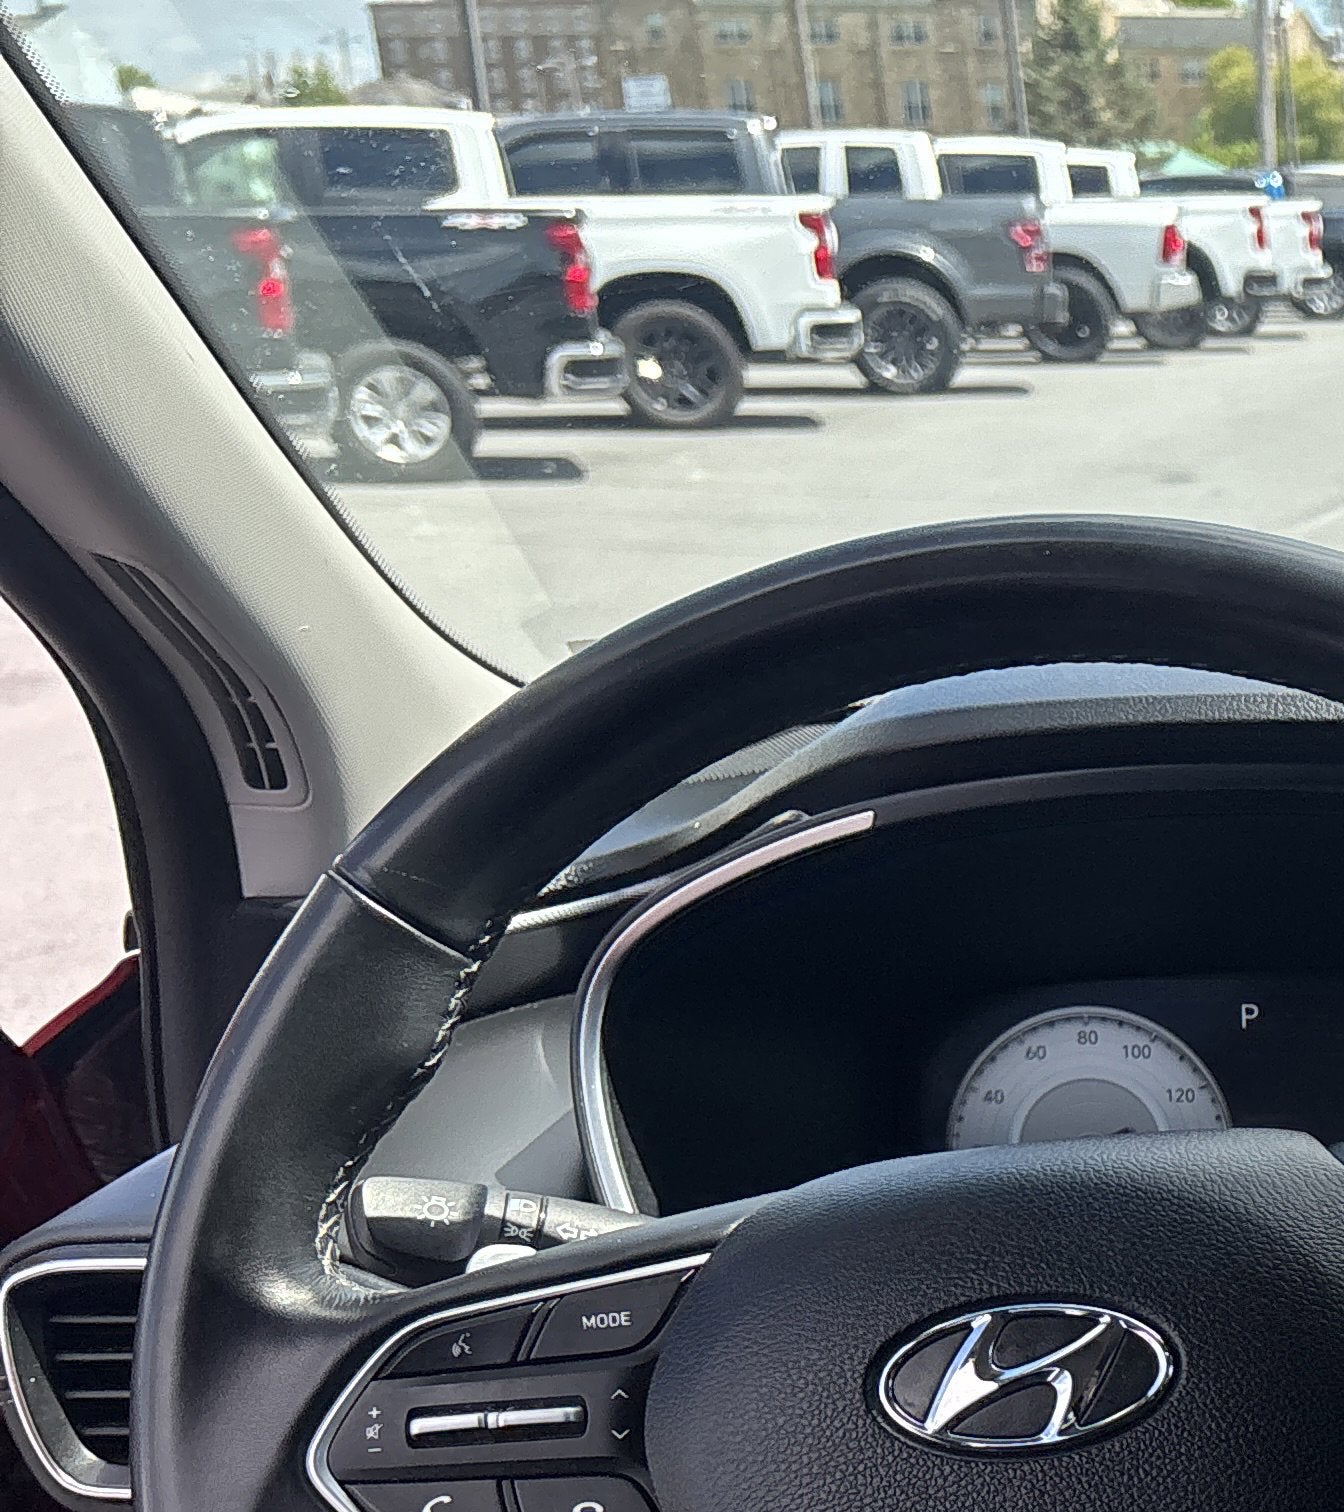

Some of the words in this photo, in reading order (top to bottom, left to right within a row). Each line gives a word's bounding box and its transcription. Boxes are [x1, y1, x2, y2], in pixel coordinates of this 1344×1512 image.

[1240, 1003, 1259, 1030] P
[1076, 1030, 1099, 1046] 80
[1025, 1045, 1048, 1061] 60
[1122, 1043, 1152, 1060] 100
[984, 1089, 1005, 1105] 40
[1165, 1087, 1196, 1104] 120
[581, 1310, 633, 1330] MODE
